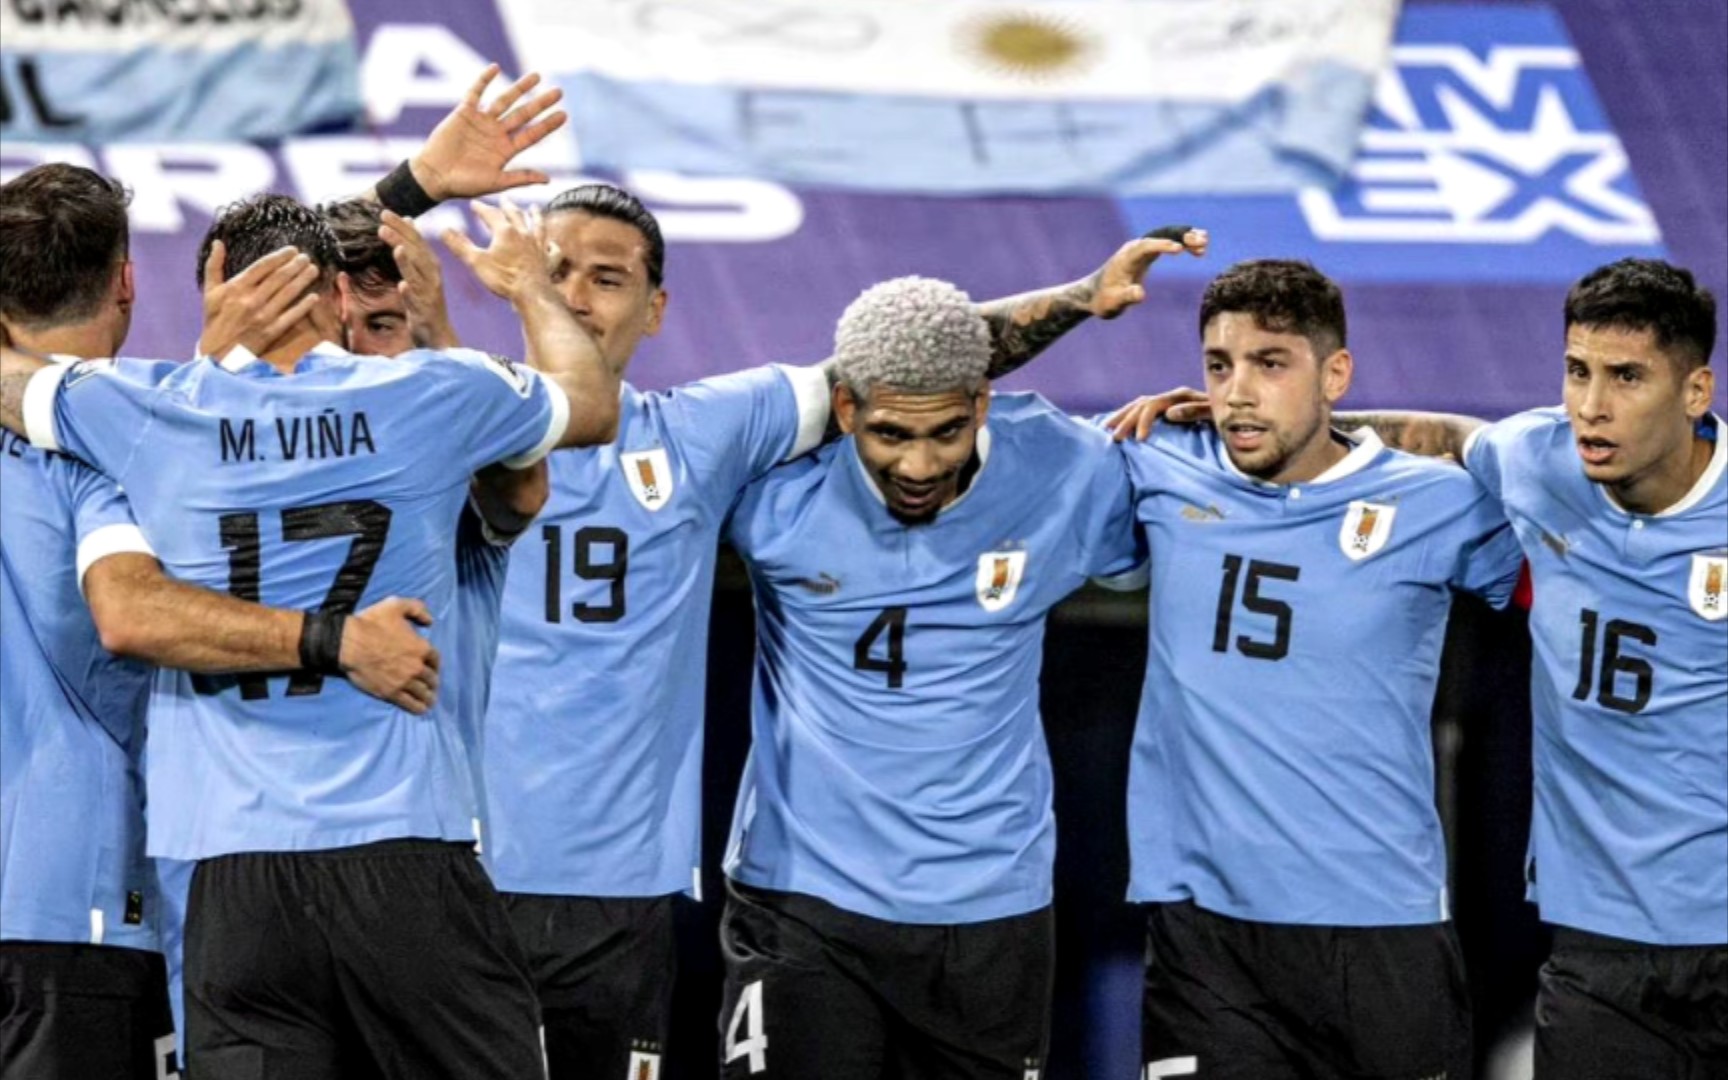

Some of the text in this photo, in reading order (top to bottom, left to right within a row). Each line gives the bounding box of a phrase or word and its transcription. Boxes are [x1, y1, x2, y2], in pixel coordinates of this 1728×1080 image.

[1362, 44, 1612, 134] M
[1302, 134, 1656, 240] EX
[219, 408, 377, 462] M. VIÑA
[218, 498, 393, 699] 17
[541, 524, 629, 624] 19
[1212, 553, 1300, 661] 15
[853, 606, 908, 689] 4
[1572, 607, 1658, 714] 16
[725, 978, 768, 1074] 4
